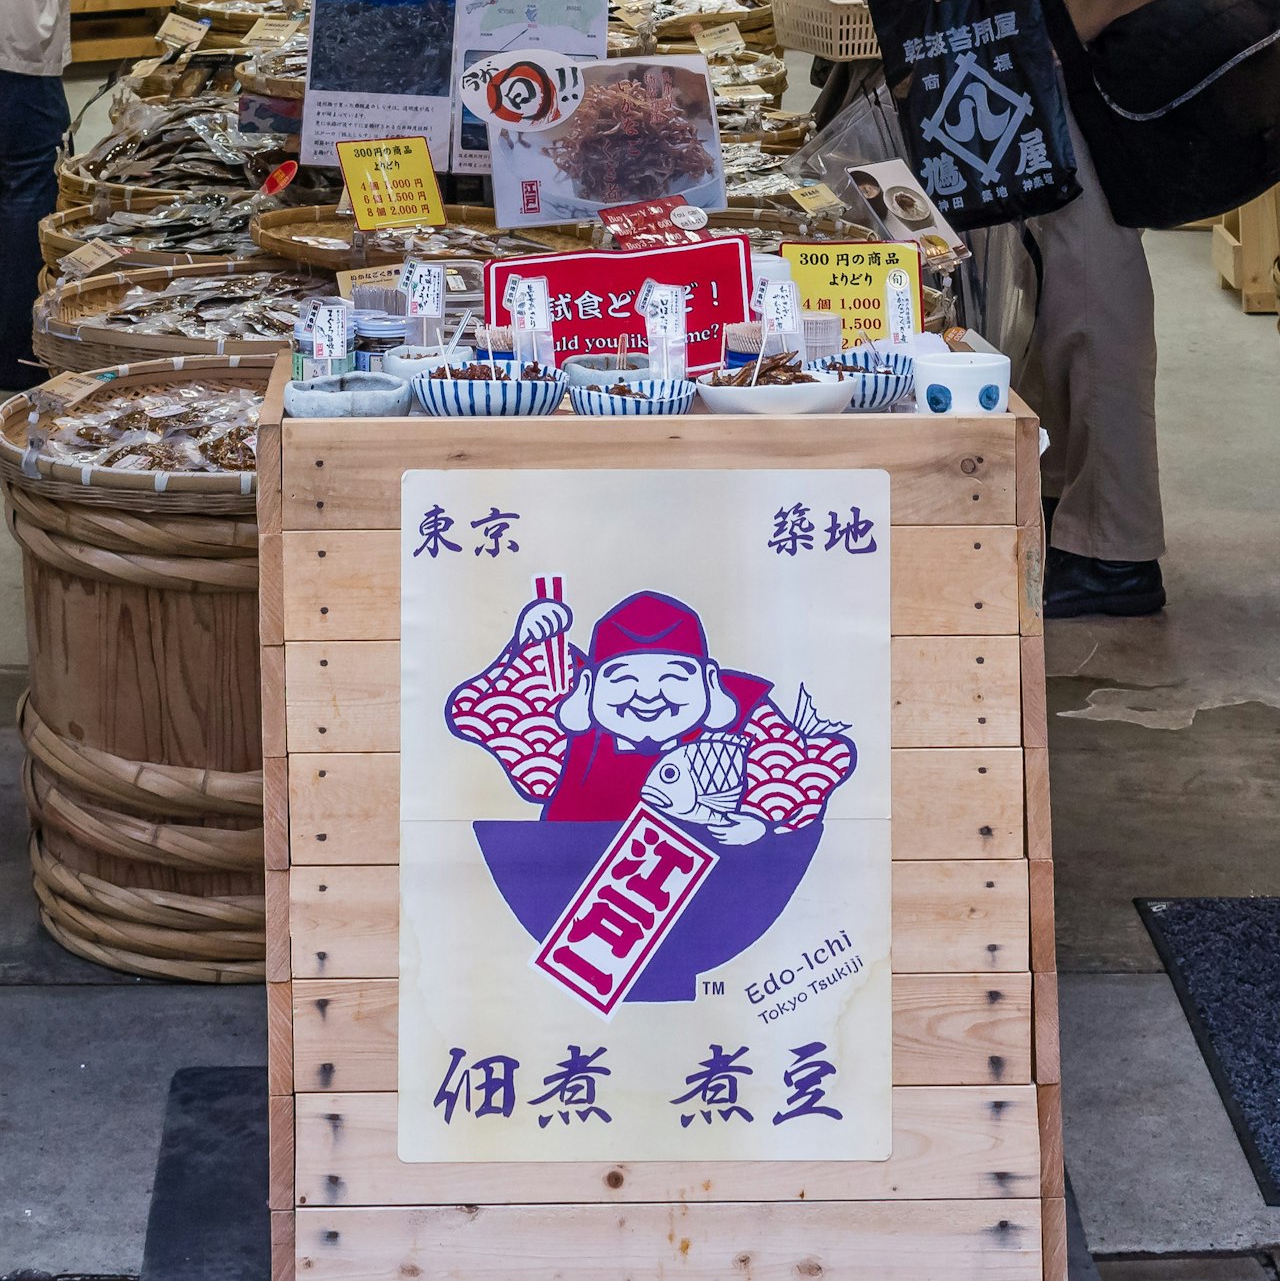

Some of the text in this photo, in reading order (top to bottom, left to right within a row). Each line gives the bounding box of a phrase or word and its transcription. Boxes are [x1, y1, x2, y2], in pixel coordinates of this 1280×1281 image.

[523, 182, 539, 213] 江戸一
[938, 196, 964, 214] 神田
[982, 184, 1009, 204] 築地
[799, 252, 900, 267] 300 円の商品
[829, 273, 873, 286] よりどり
[892, 274, 904, 287] 旬
[839, 298, 881, 311] 1,000
[841, 318, 882, 331] 1,500
[553, 338, 579, 352] uld
[585, 339, 618, 354] you
[626, 334, 648, 348] lik
[413, 504, 521, 559] 東京
[767, 501, 878, 557] 築地
[552, 825, 695, 998] 江戸一
[744, 929, 854, 1007] Edo-Ichi
[702, 981, 725, 996] TM
[757, 954, 866, 1027] Tokyo Tsukiji
[433, 1041, 843, 1129] 佃煮 煮豆
